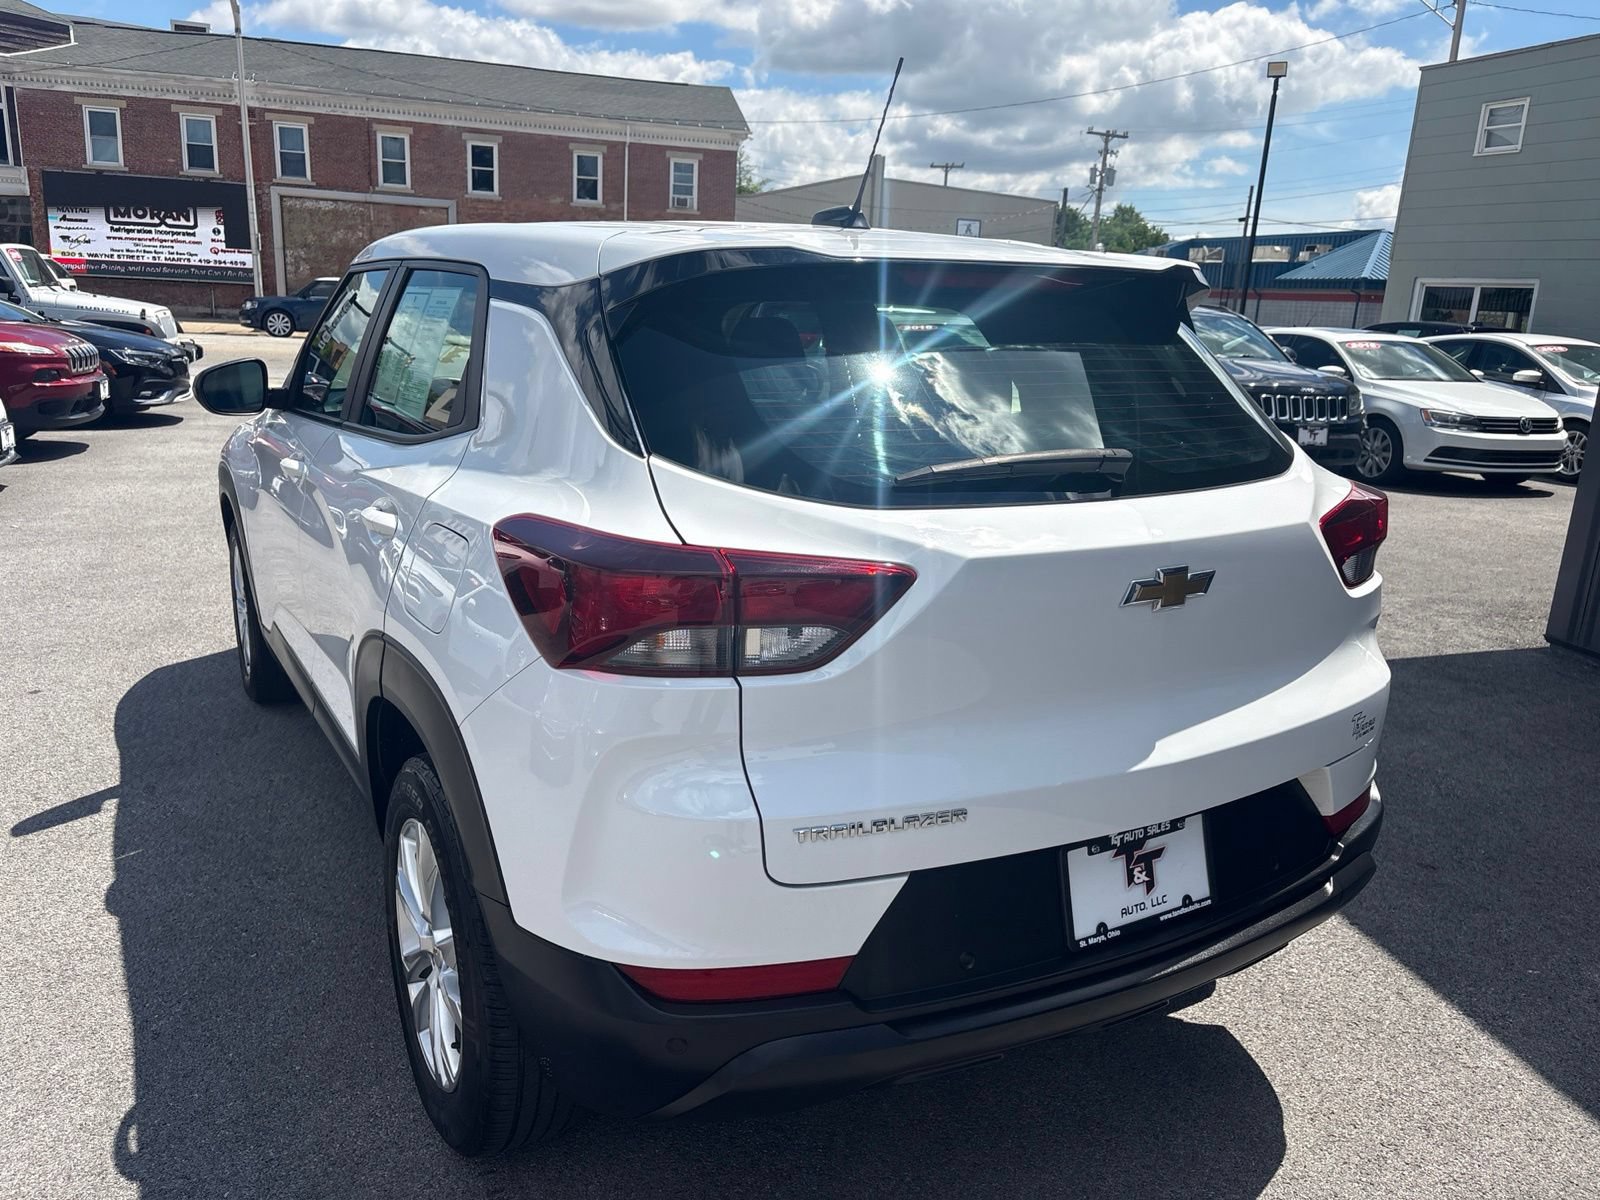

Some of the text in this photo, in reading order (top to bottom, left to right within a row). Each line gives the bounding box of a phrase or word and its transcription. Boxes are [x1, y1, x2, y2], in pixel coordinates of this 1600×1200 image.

[113, 207, 191, 222] MORAN
[110, 226, 196, 238] Refrigeration Incorporated
[106, 236, 202, 245] www.moranrefrigeration.com
[100, 263, 126, 272] Pricing
[161, 266, 190, 274] Service
[77, 305, 129, 314] RUBICON
[792, 807, 968, 844] TRAILBLAZER
[1123, 828, 1144, 844] AUTO
[1146, 820, 1171, 836] SALES
[1150, 894, 1168, 907] LLC
[1107, 929, 1121, 939] Ohio
